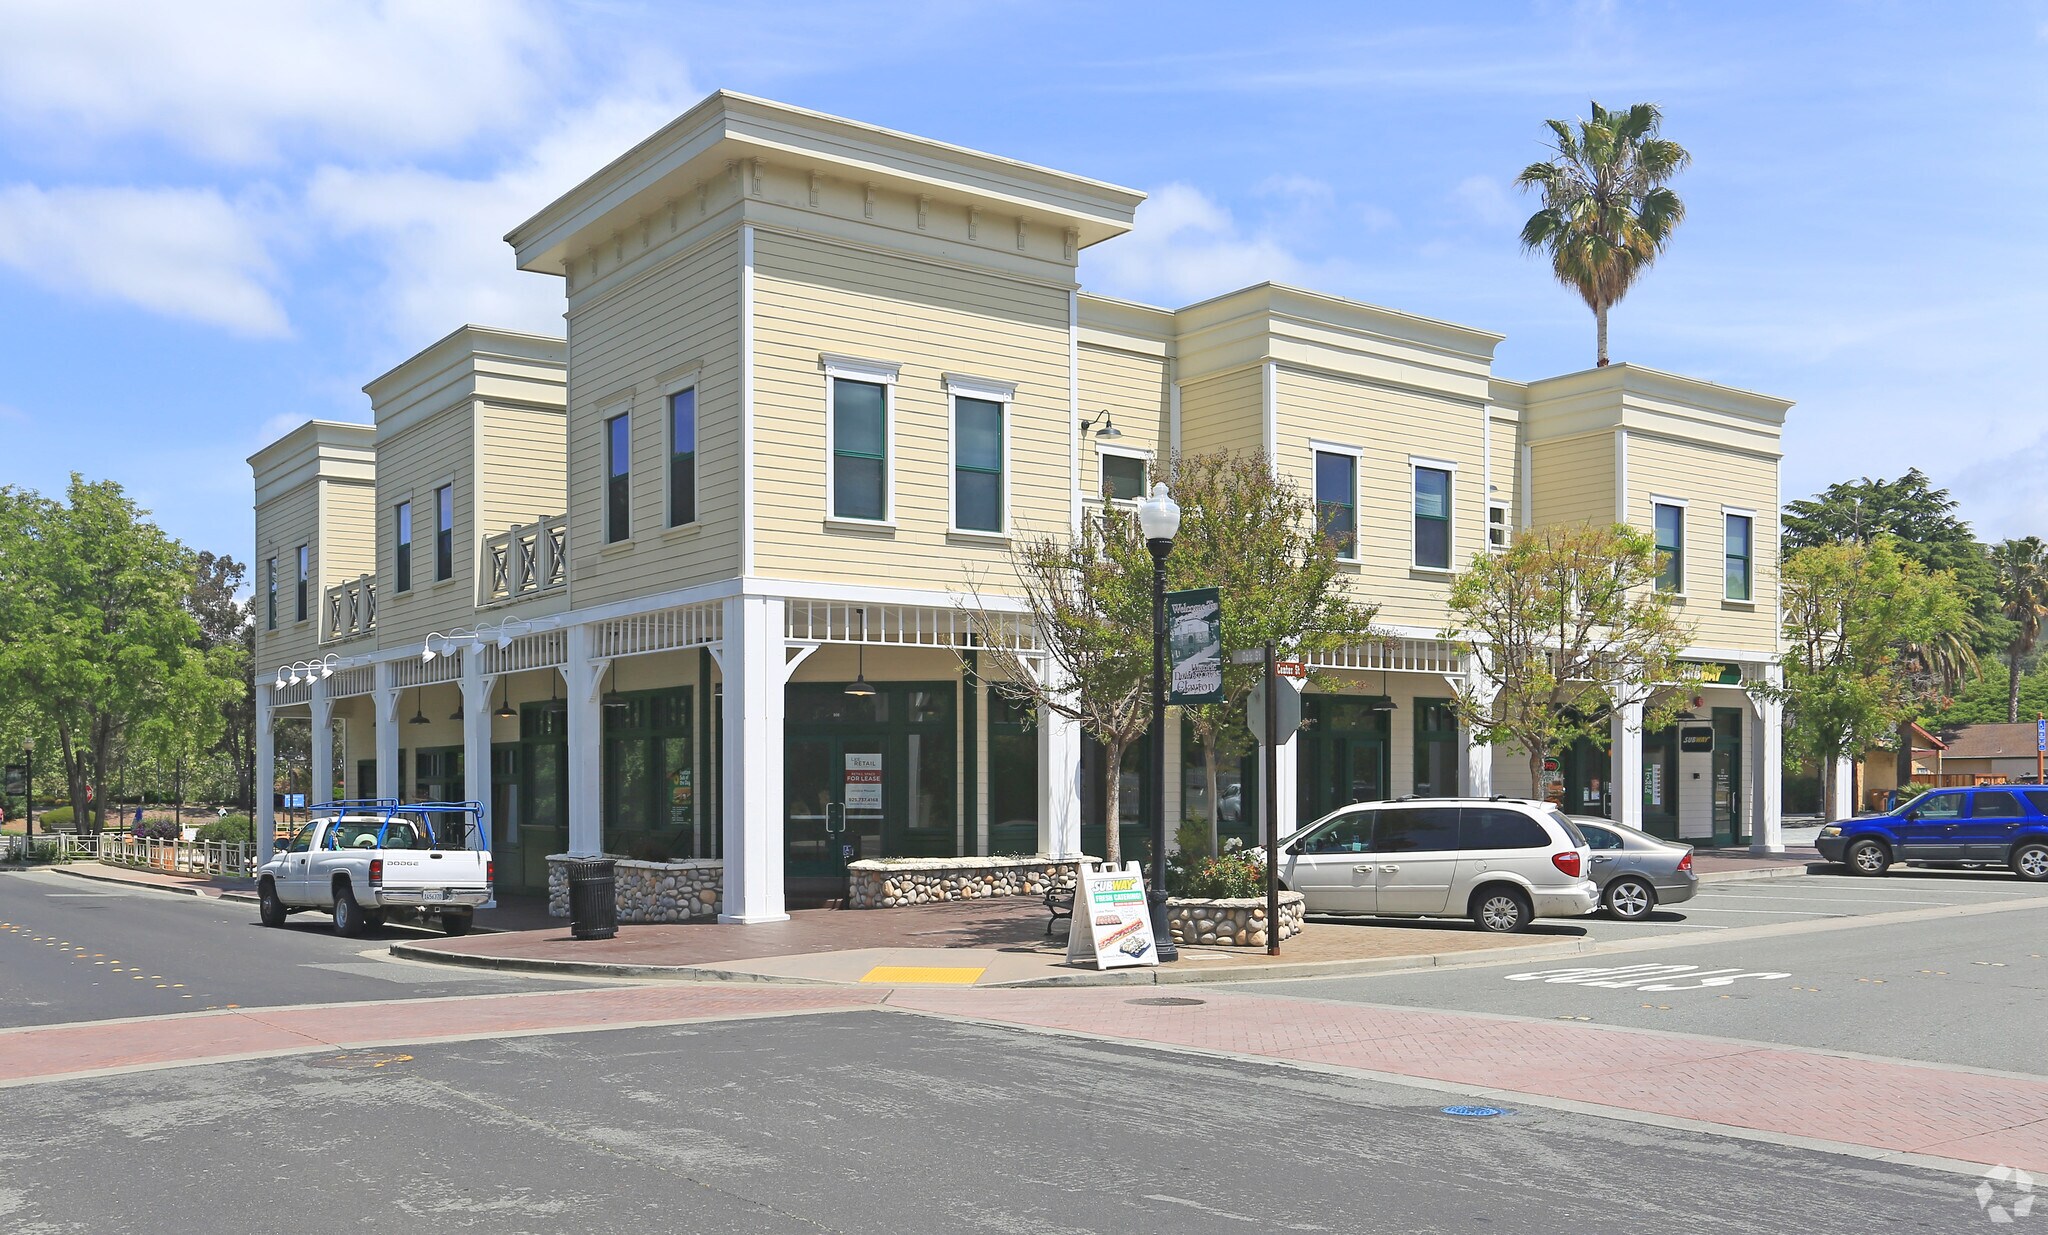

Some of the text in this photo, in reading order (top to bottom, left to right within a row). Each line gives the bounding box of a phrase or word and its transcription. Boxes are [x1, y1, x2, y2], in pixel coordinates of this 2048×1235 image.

[1172, 600, 1218, 614] Welcome To
[1276, 663, 1301, 675] Center St
[1177, 680, 1215, 694] Clayton
[1683, 736, 1711, 744] SUBWAY
[1092, 879, 1137, 892] SUBWAY
[1095, 894, 1113, 903] FRESH
